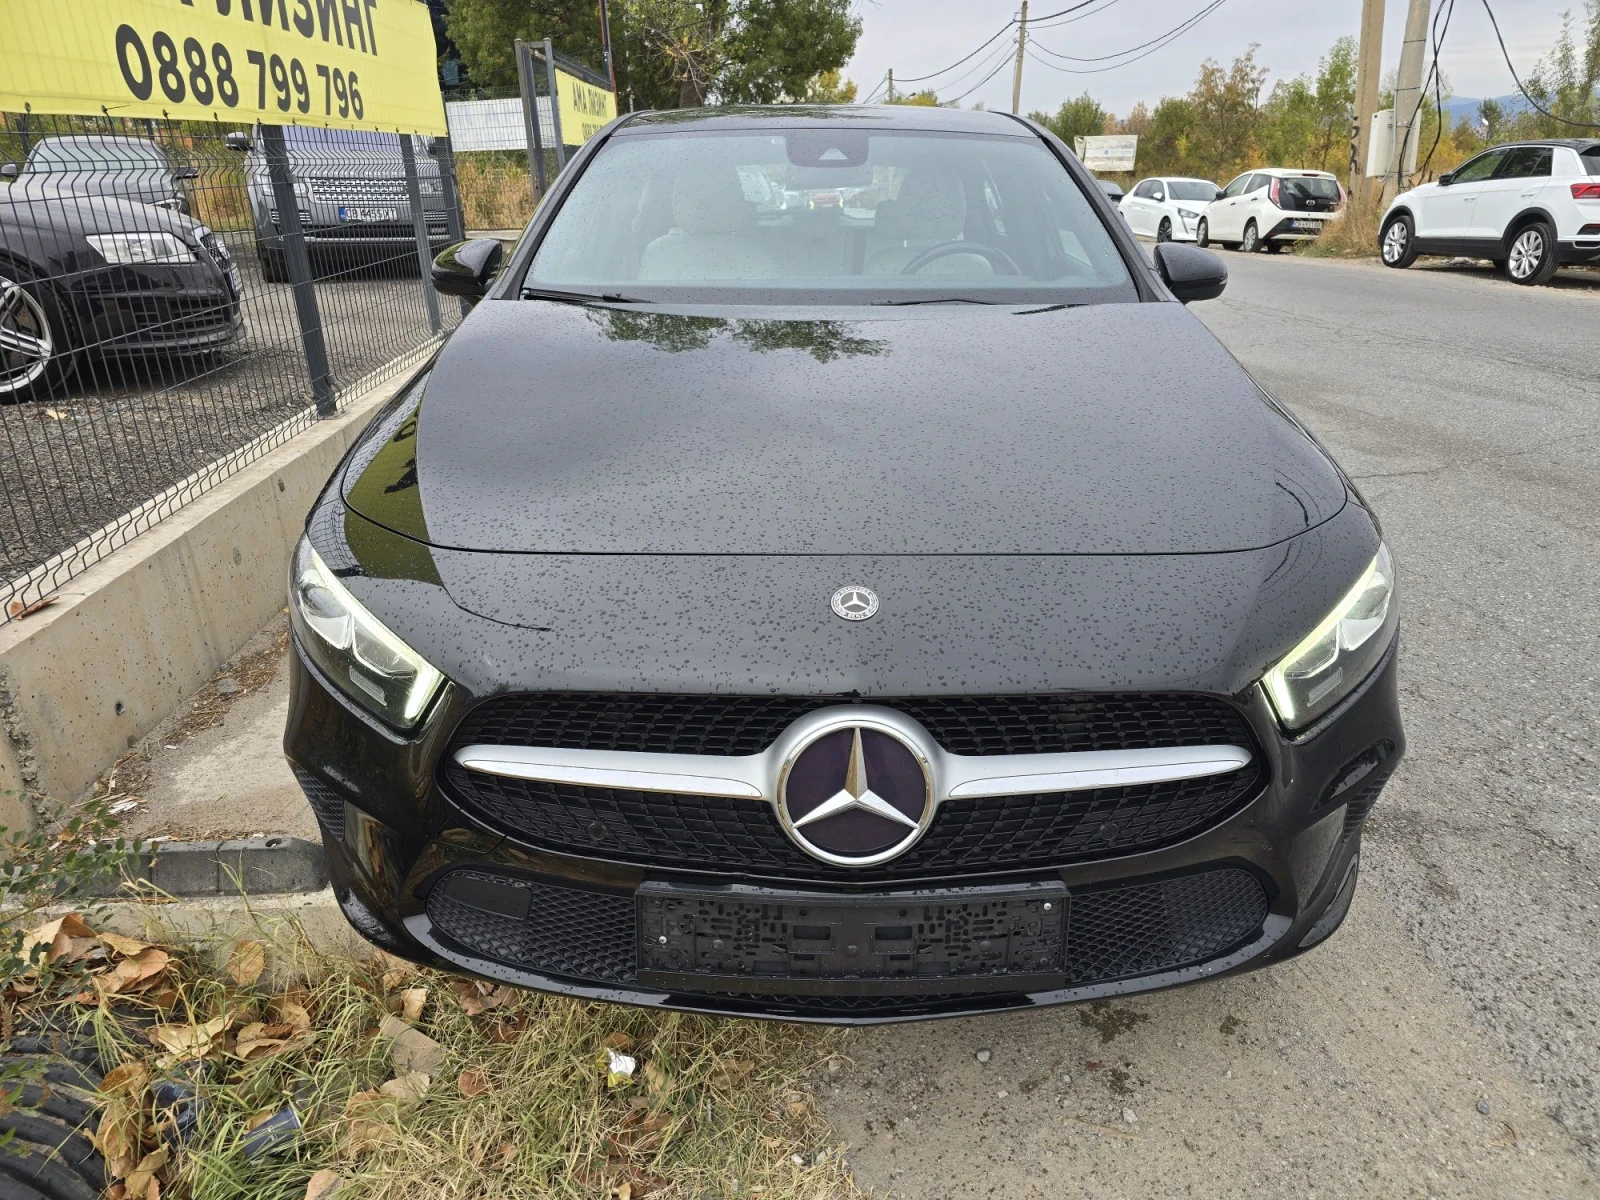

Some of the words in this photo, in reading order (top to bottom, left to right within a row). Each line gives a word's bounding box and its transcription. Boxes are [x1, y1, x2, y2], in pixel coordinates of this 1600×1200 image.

[115, 23, 239, 108] 0888
[246, 49, 310, 114] 799
[316, 63, 364, 120] 796
